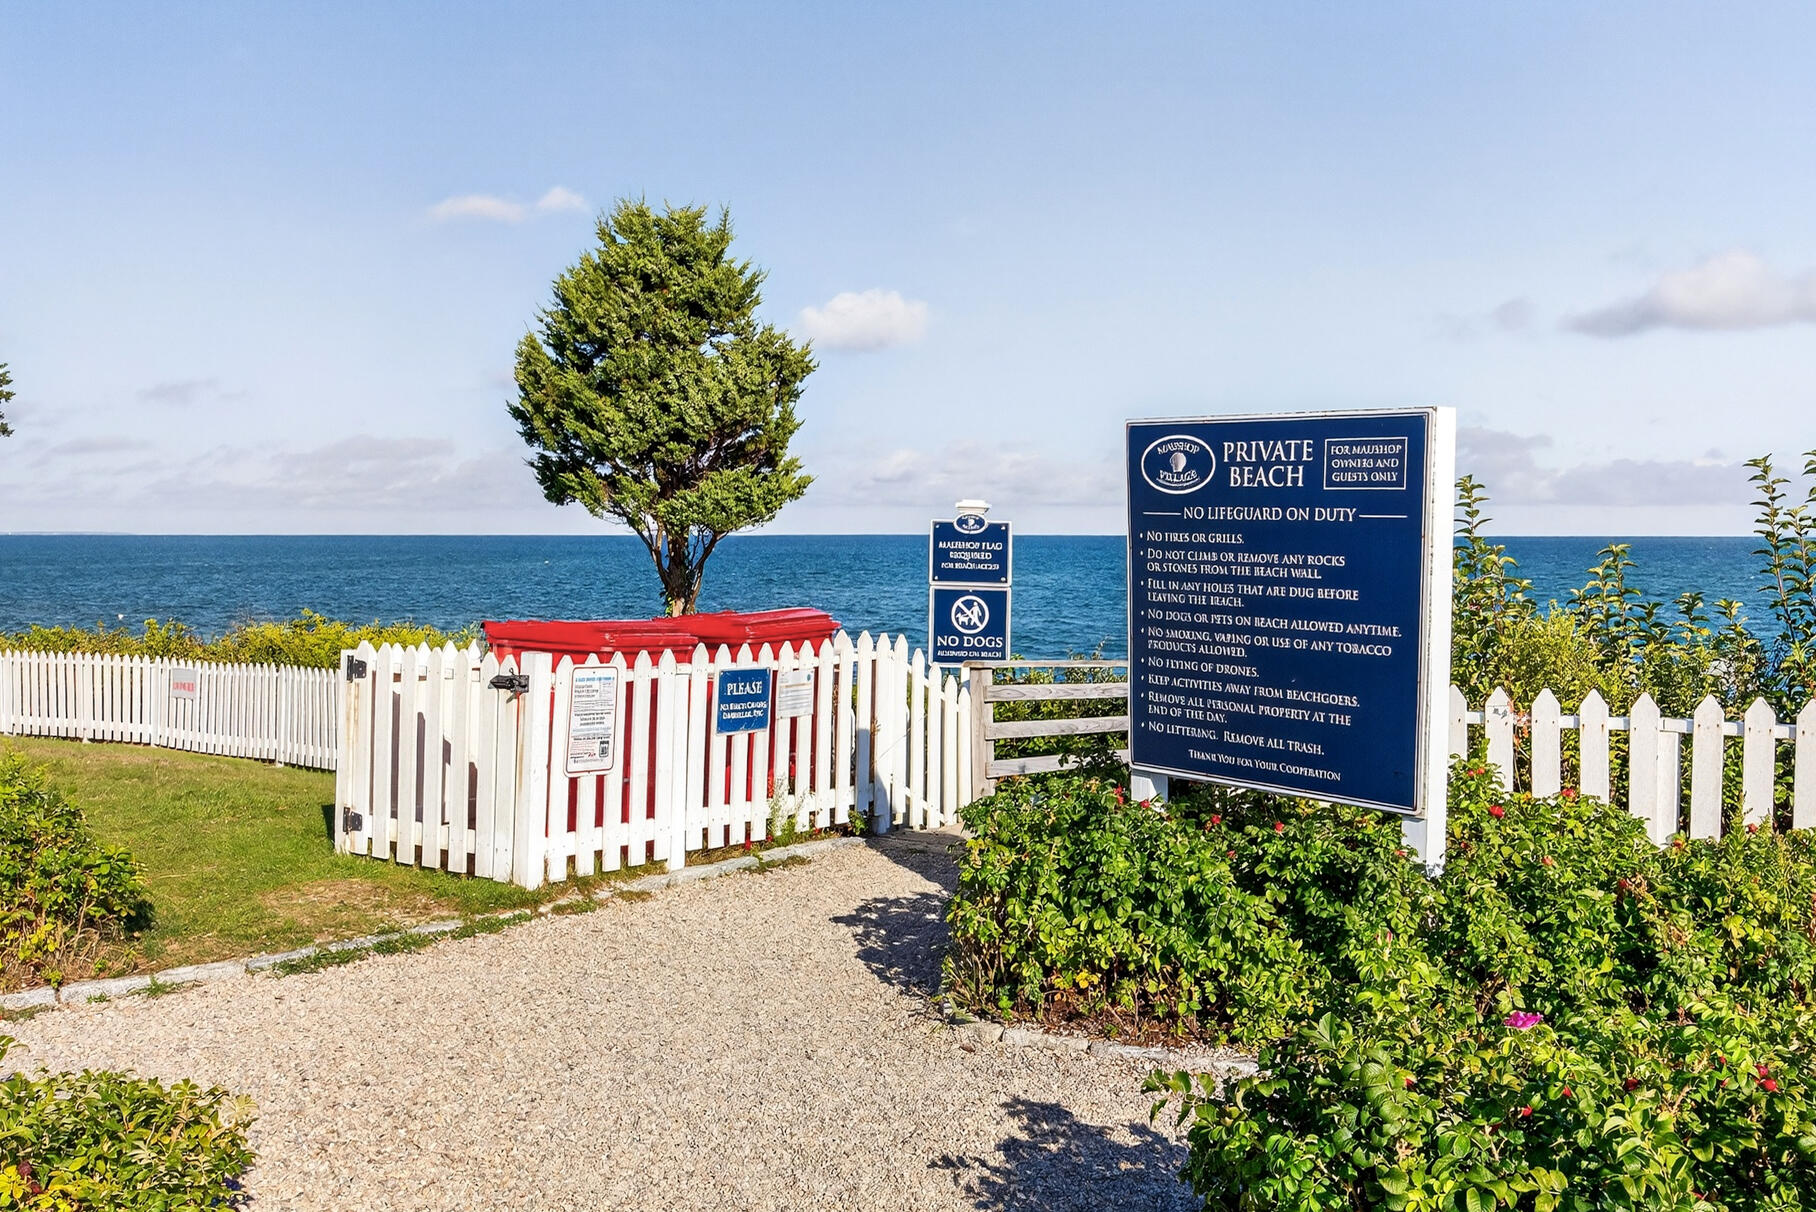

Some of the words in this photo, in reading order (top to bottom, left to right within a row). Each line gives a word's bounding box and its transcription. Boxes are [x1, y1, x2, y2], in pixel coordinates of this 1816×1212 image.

[1157, 442, 1200, 454] MAUSHOP
[1223, 440, 1314, 462] PRIVATE
[1330, 445, 1351, 455] FOR
[1376, 458, 1399, 467] AND
[1229, 466, 1304, 487] BEACH
[1332, 472, 1368, 481] GUESTS
[1371, 472, 1398, 481] ONLY
[1183, 506, 1205, 520] NO
[1207, 507, 1282, 520] LIFEGUARD
[1286, 507, 1309, 520] ON
[1314, 508, 1356, 521] DUTY
[1146, 531, 1162, 541] NO
[1165, 532, 1190, 542] FIRES
[1192, 532, 1207, 543] OR
[1208, 533, 1245, 544] GRILLS.
[1147, 548, 1162, 559] DO
[1165, 550, 1185, 560] NOT
[1188, 551, 1218, 561] CLIMB
[1220, 552, 1235, 562] OR
[1237, 553, 1279, 564] REMOVE
[1281, 554, 1304, 565] ANY
[1307, 556, 1345, 566] ROCKS
[1147, 562, 1161, 572] OR
[1162, 562, 1198, 573] STONES
[1200, 564, 1228, 575] FROM
[1230, 565, 1251, 576] THE
[1254, 567, 1288, 578] BEACH
[1147, 578, 1166, 590] FILL
[1168, 580, 1179, 590] IN
[1181, 582, 1200, 591] ANY
[1203, 582, 1235, 593] HOLES
[1237, 584, 1263, 595] THAT
[1266, 586, 1286, 597] ARE
[1289, 586, 1314, 598] DUG
[1317, 588, 1359, 600] BEFORE
[1148, 592, 1186, 604] LEAVING
[1188, 594, 1207, 605] THE
[1148, 608, 1163, 620] NO
[1165, 610, 1192, 622] DOGS
[1193, 613, 1209, 623] OR
[1235, 616, 1251, 626] ON
[1254, 617, 1288, 629] BEACH
[1291, 619, 1344, 633] ALLOWED
[1346, 623, 1402, 637] ANYTIME.
[937, 635, 960, 647] NO
[963, 636, 1003, 648] DOGS
[1148, 626, 1164, 637] NO
[1214, 632, 1251, 646] VAPING
[1253, 635, 1270, 646] OR
[1272, 637, 1291, 648] USE
[1293, 638, 1309, 649] OF
[1311, 640, 1335, 652] ANY
[1336, 642, 1392, 656] TOBACCO
[1148, 639, 1196, 653] PRODUCTS
[1198, 644, 1248, 658] ALLOWED.
[1148, 656, 1164, 667] NO
[1166, 659, 1199, 671] FLYING
[1200, 662, 1214, 673] OF
[1216, 663, 1260, 678] DRONES.
[727, 681, 763, 696] PLEASE
[1148, 673, 1170, 684] KEEP
[1171, 677, 1223, 692] ACTIVITIES
[1224, 683, 1252, 696] AWAY
[1254, 686, 1283, 698] FROM
[1286, 689, 1360, 707] BEACHGOERS.
[1148, 691, 1186, 706] REMOVE
[1188, 697, 1205, 707] ALL
[1206, 698, 1256, 714] PERSONAL
[1258, 705, 1311, 721] PROPERTY
[1312, 711, 1326, 722] AT
[1328, 713, 1351, 726] THE
[1148, 704, 1168, 715] END
[1169, 707, 1182, 717] OF
[1184, 708, 1204, 720] THE
[1206, 711, 1228, 724] DAY.
[1148, 721, 1164, 732] NO
[1166, 724, 1219, 740] LITTERING.
[1223, 730, 1265, 747] REMOVE
[1266, 738, 1285, 749] ALL
[1287, 740, 1325, 756] TRASH.
[1188, 749, 1217, 762] THANK
[1216, 753, 1236, 765] YOU
[1236, 757, 1253, 768] FOR
[1254, 759, 1279, 771] YOUR
[1279, 763, 1341, 781] COOPERATION
